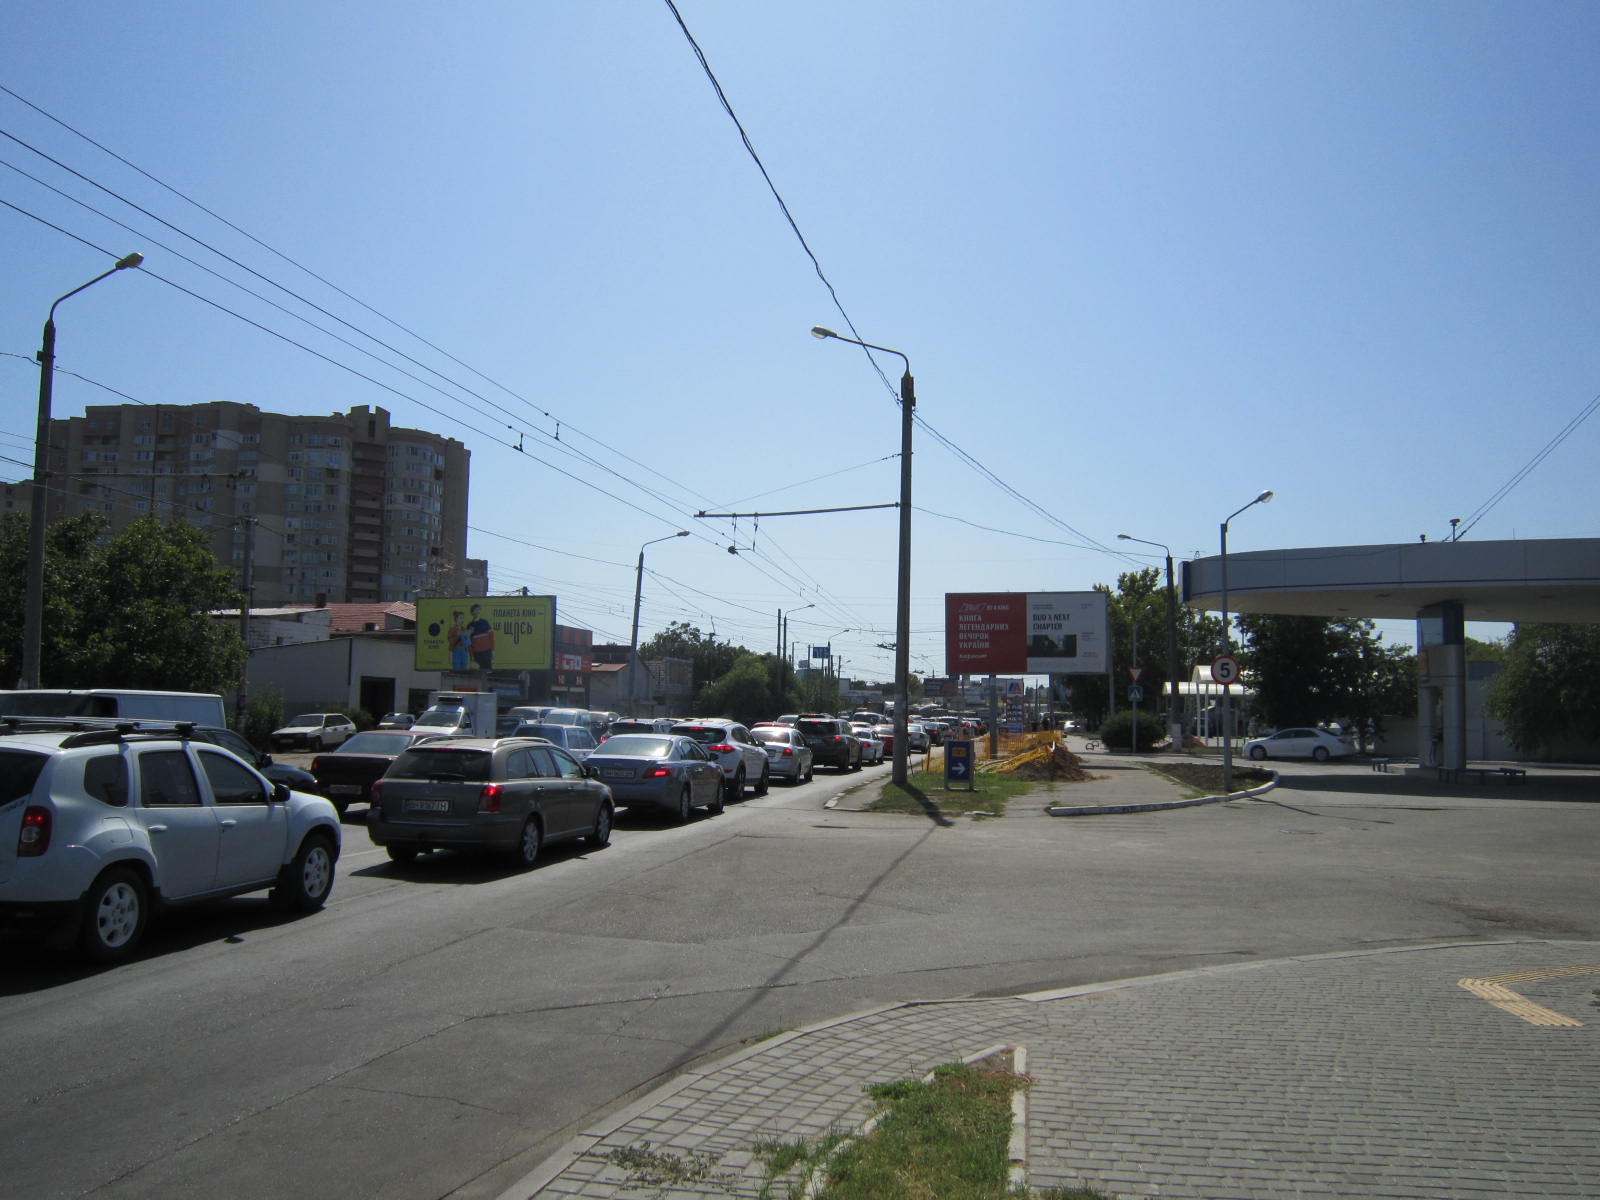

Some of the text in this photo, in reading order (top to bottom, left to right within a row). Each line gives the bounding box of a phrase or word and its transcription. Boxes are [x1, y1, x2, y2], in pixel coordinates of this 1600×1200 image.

[1053, 613, 1070, 621] NEXT
[1032, 622, 1063, 631] CHAPTER
[503, 621, 533, 645] ЩОСЬ
[1220, 662, 1231, 678] 5
